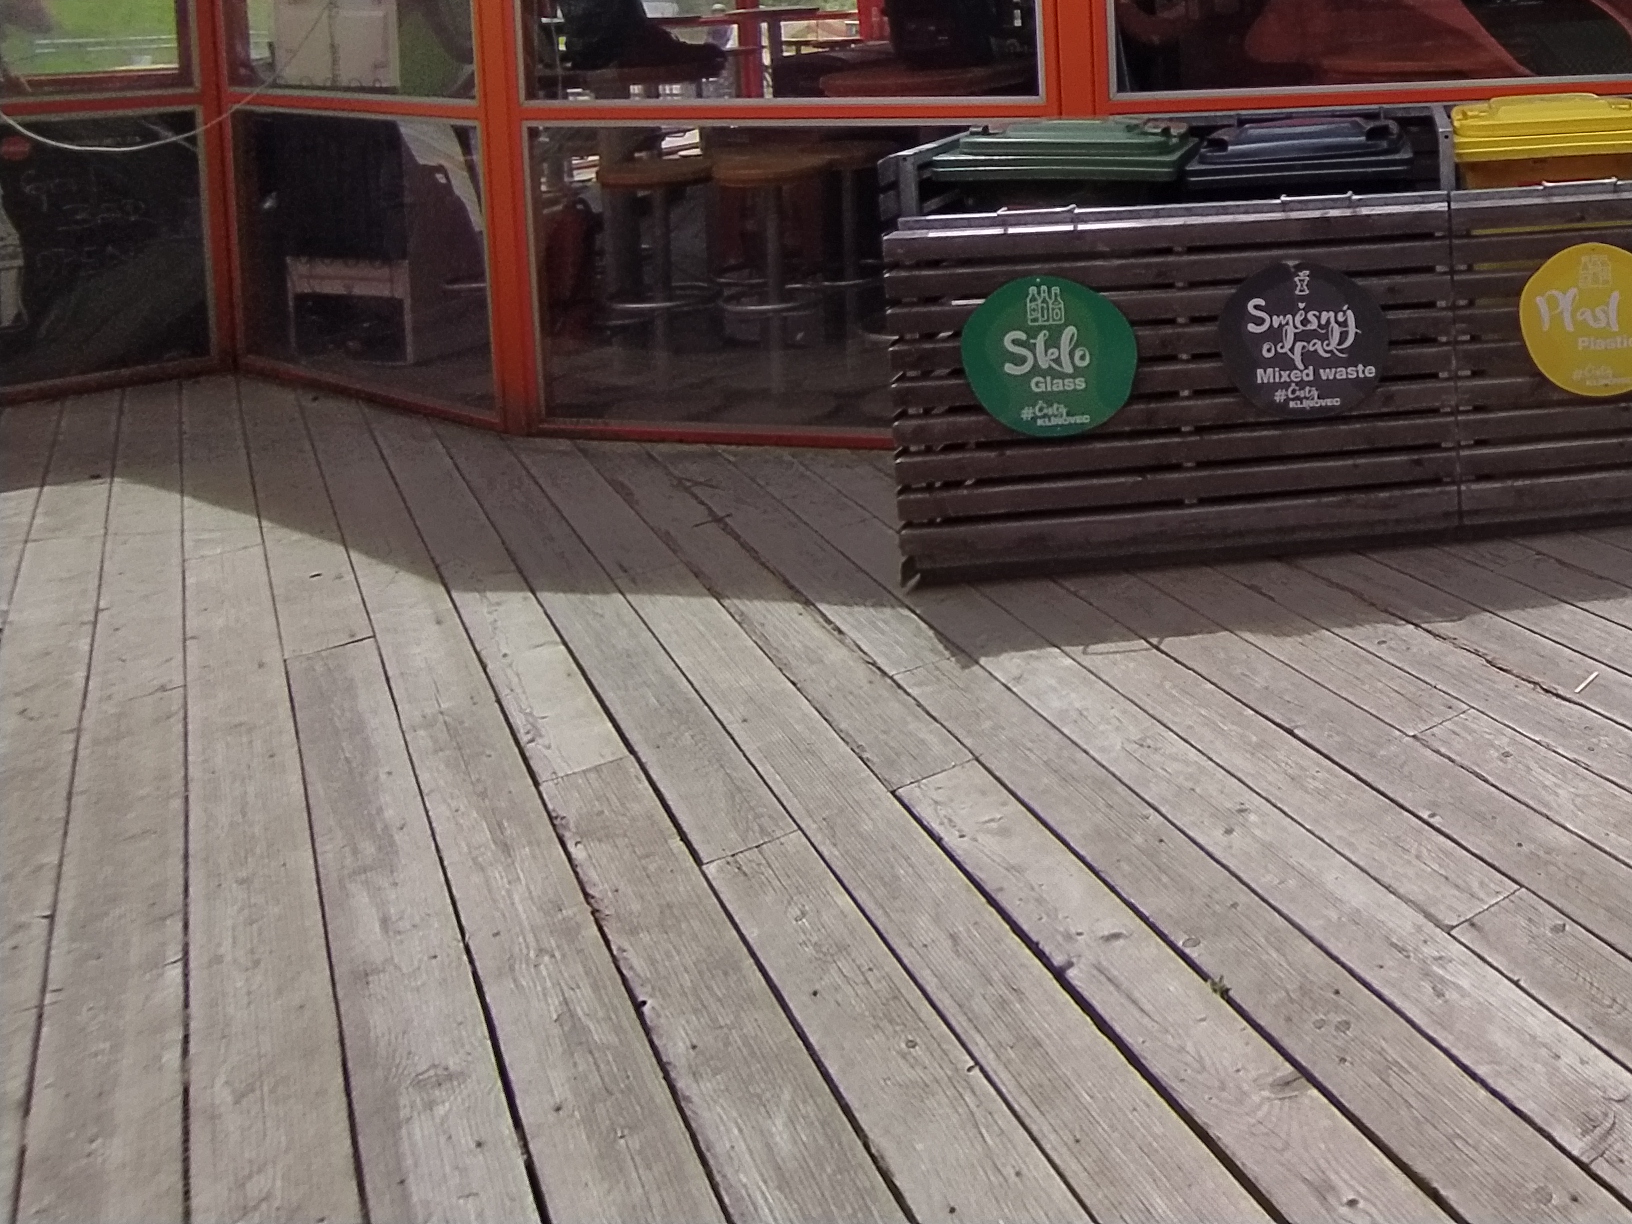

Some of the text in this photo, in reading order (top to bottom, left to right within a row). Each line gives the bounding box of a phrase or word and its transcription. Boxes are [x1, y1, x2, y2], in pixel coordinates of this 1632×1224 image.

[1247, 297, 1362, 349] Směsný
[1003, 325, 1091, 375] Sklo
[1261, 325, 1349, 370] odpad
[1030, 376, 1087, 393] Glass
[1256, 363, 1376, 384] Mixed waste
